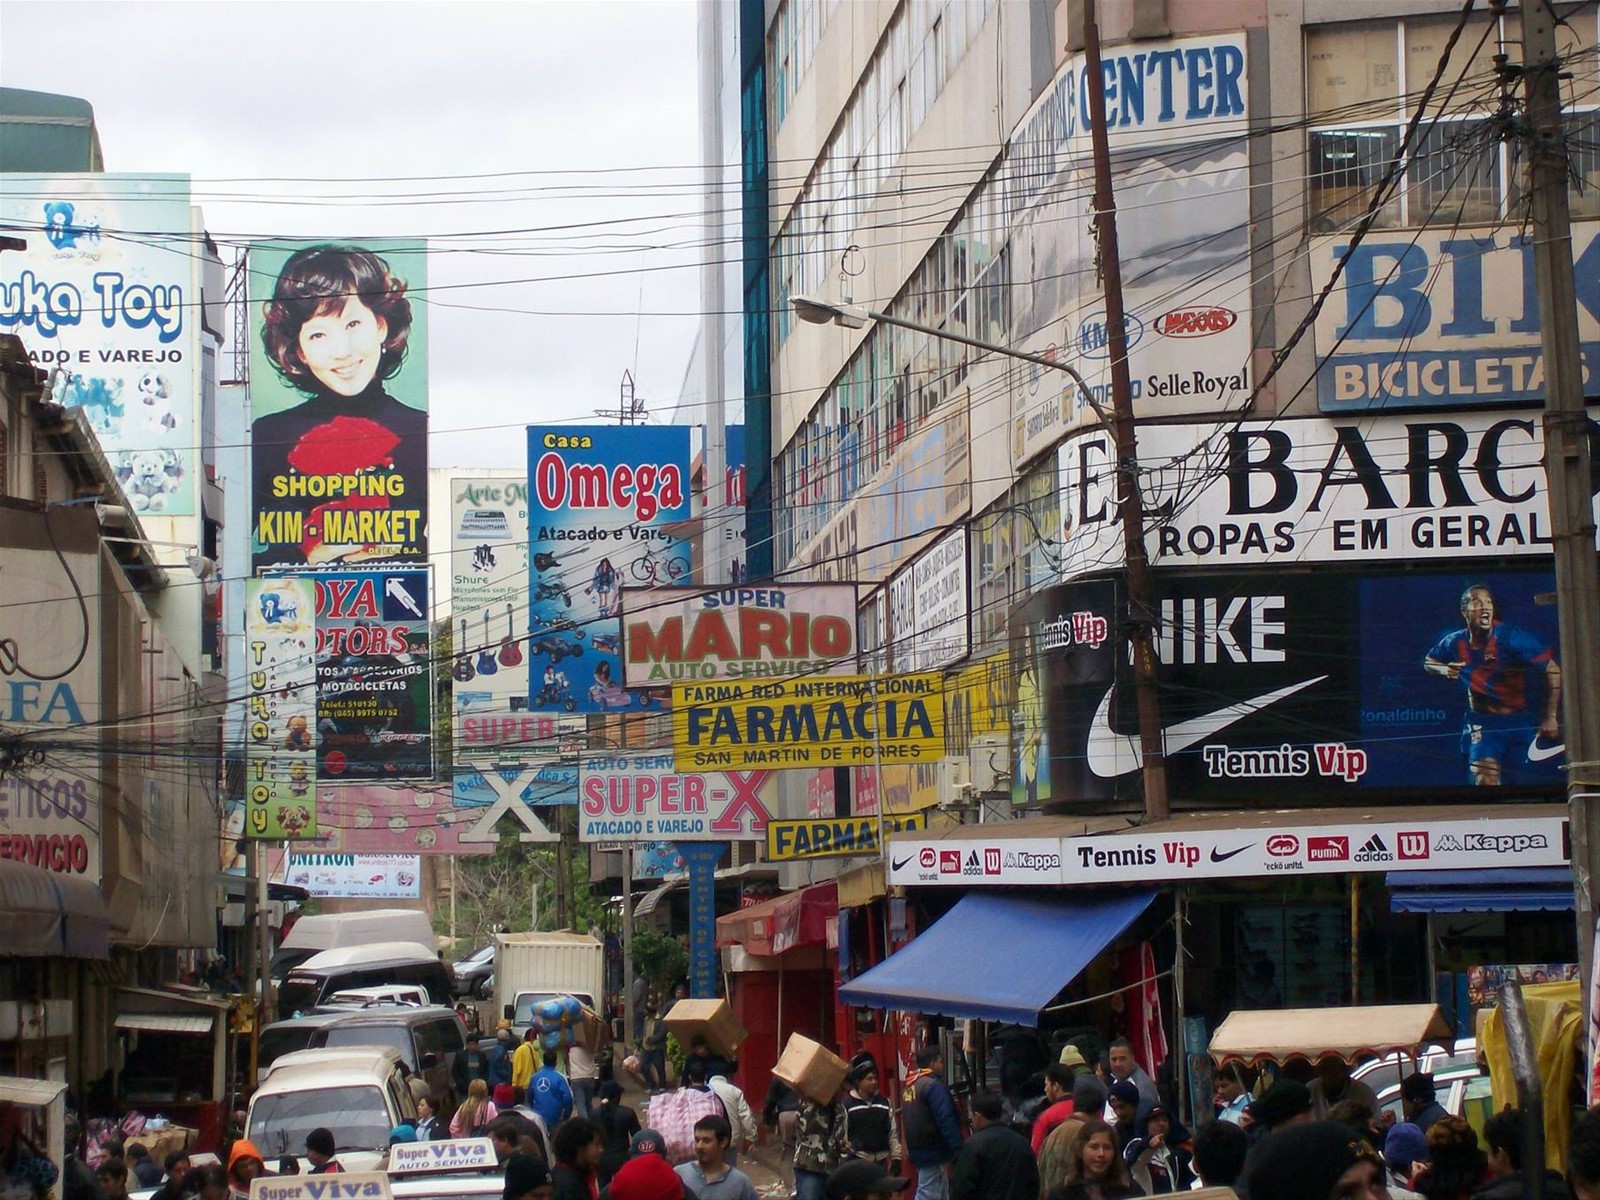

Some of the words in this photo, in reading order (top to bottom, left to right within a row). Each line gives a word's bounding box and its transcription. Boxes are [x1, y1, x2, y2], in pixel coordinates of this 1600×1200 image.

[93, 272, 183, 343] Toy
[1164, 311, 1229, 334] MAXXIS
[79, 350, 91, 363] E
[99, 350, 183, 363] VAREJO
[1147, 374, 1190, 397] Selle
[1192, 366, 1248, 400] Royal
[543, 433, 593, 449] Casa
[272, 474, 405, 498] SHOPPING
[456, 484, 502, 507] Arte
[535, 451, 684, 522] Omega
[259, 511, 303, 544] KIM
[323, 509, 421, 544] MARKET
[538, 526, 608, 542] Atacado
[613, 530, 624, 541] e
[629, 525, 681, 544] Varej
[1160, 521, 1296, 557] ROPAS
[1333, 518, 1388, 551] EM
[1411, 512, 1553, 549] GERAL
[454, 575, 489, 585] Shure
[703, 589, 786, 609] SUPER
[628, 608, 851, 663] MARIO
[1073, 612, 1107, 649] Vip
[649, 663, 717, 679] AUTO
[322, 681, 407, 692] MOTOCICLETAS
[684, 685, 744, 702] FARMA
[752, 683, 785, 699] RED
[794, 678, 935, 698] INTERNACIONAL
[463, 716, 554, 742] SUPER
[687, 699, 934, 746] FARMACIA
[694, 751, 731, 765] SAN
[743, 747, 810, 764] MARTIN
[821, 746, 842, 760] DE
[852, 745, 921, 760] PORRES
[1204, 743, 1309, 777] Tennis
[1313, 742, 1368, 783] Vip
[583, 768, 776, 834] SUPER-X
[587, 820, 642, 836] ATACADO
[646, 820, 654, 833] E
[657, 819, 704, 834] VAREJO
[1311, 848, 1340, 859] PUMA
[1465, 834, 1548, 853] Kappa
[1017, 852, 1060, 871] Kappa
[1077, 843, 1156, 869] Tennis
[1163, 840, 1201, 869] Vip
[1353, 851, 1394, 863] adidas
[963, 867, 983, 876] adidas
[396, 1147, 429, 1162] Super
[429, 1143, 487, 1159] Viva
[399, 1161, 430, 1171] AUTO
[434, 1157, 486, 1168] SERVICE
[259, 1185, 302, 1200] Super
[304, 1179, 381, 1199] Viva
